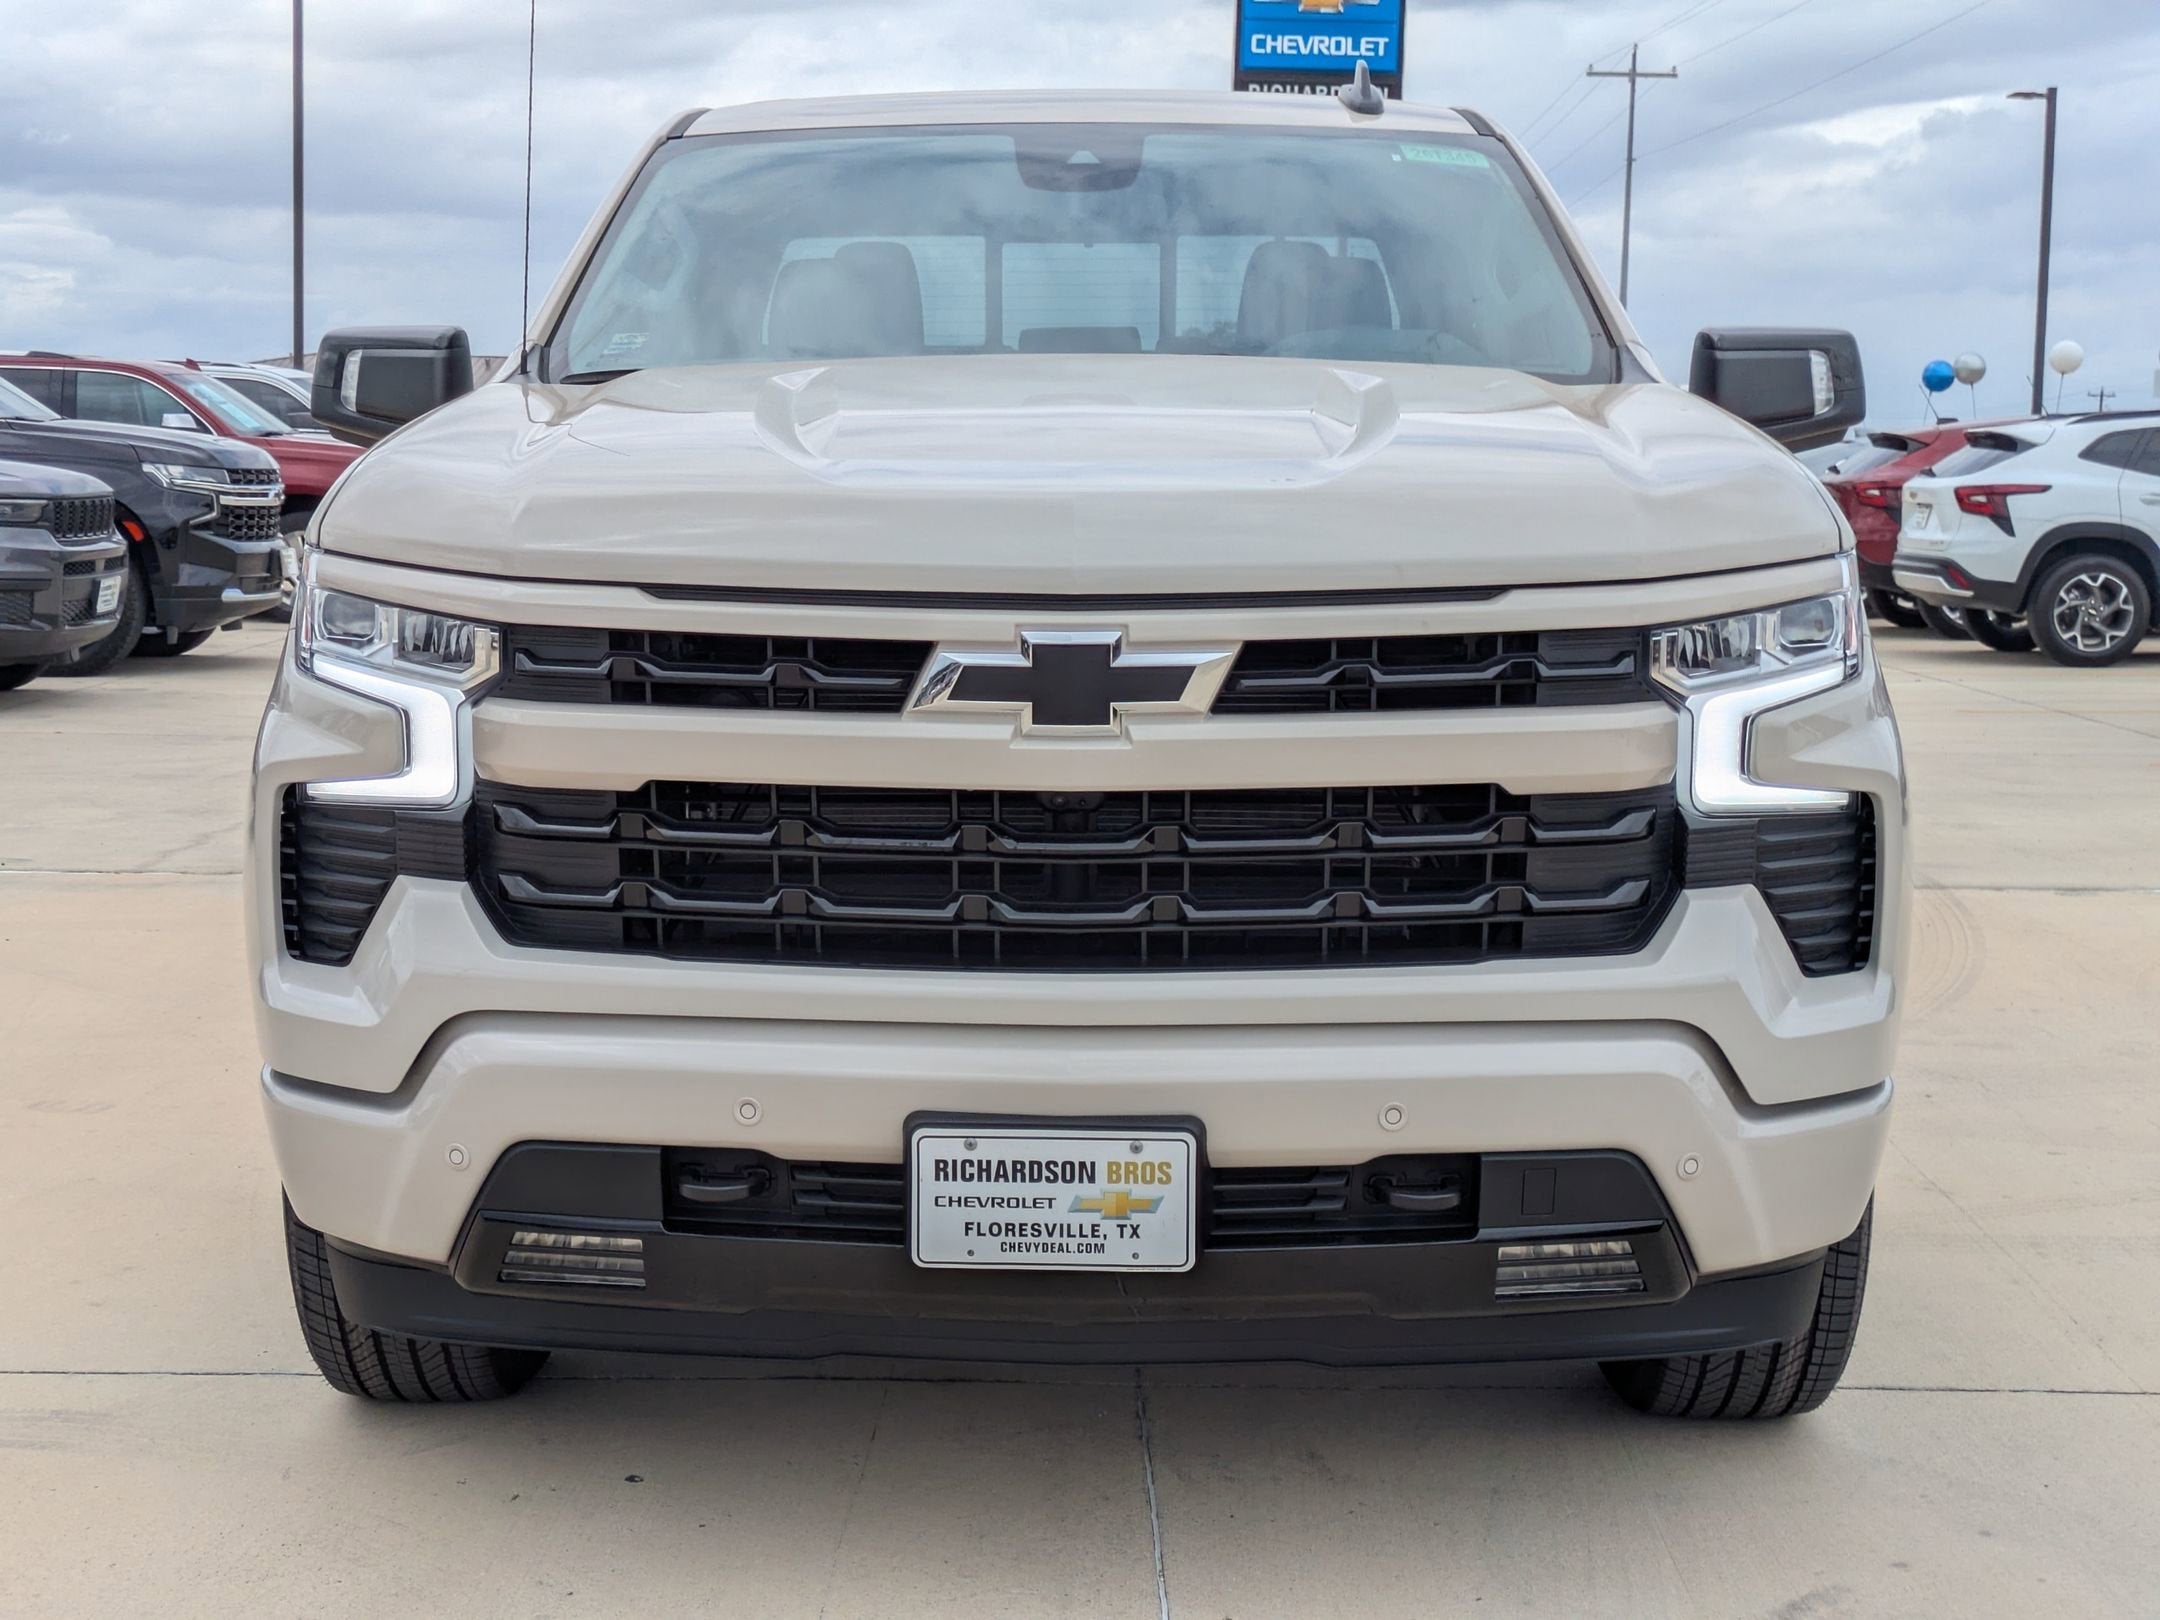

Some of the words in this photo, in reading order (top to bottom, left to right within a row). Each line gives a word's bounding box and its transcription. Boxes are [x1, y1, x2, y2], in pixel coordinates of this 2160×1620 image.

[1250, 33, 1389, 57] CHEVROLET
[934, 1158, 1096, 1184] RICHARDSON
[1106, 1161, 1172, 1185] BROS
[934, 1195, 1057, 1209] CHEVROLET
[964, 1221, 1108, 1241] FLORESVILLE,
[1116, 1223, 1141, 1239] TX
[1000, 1241, 1106, 1255] CHEVYDEAL.COM
